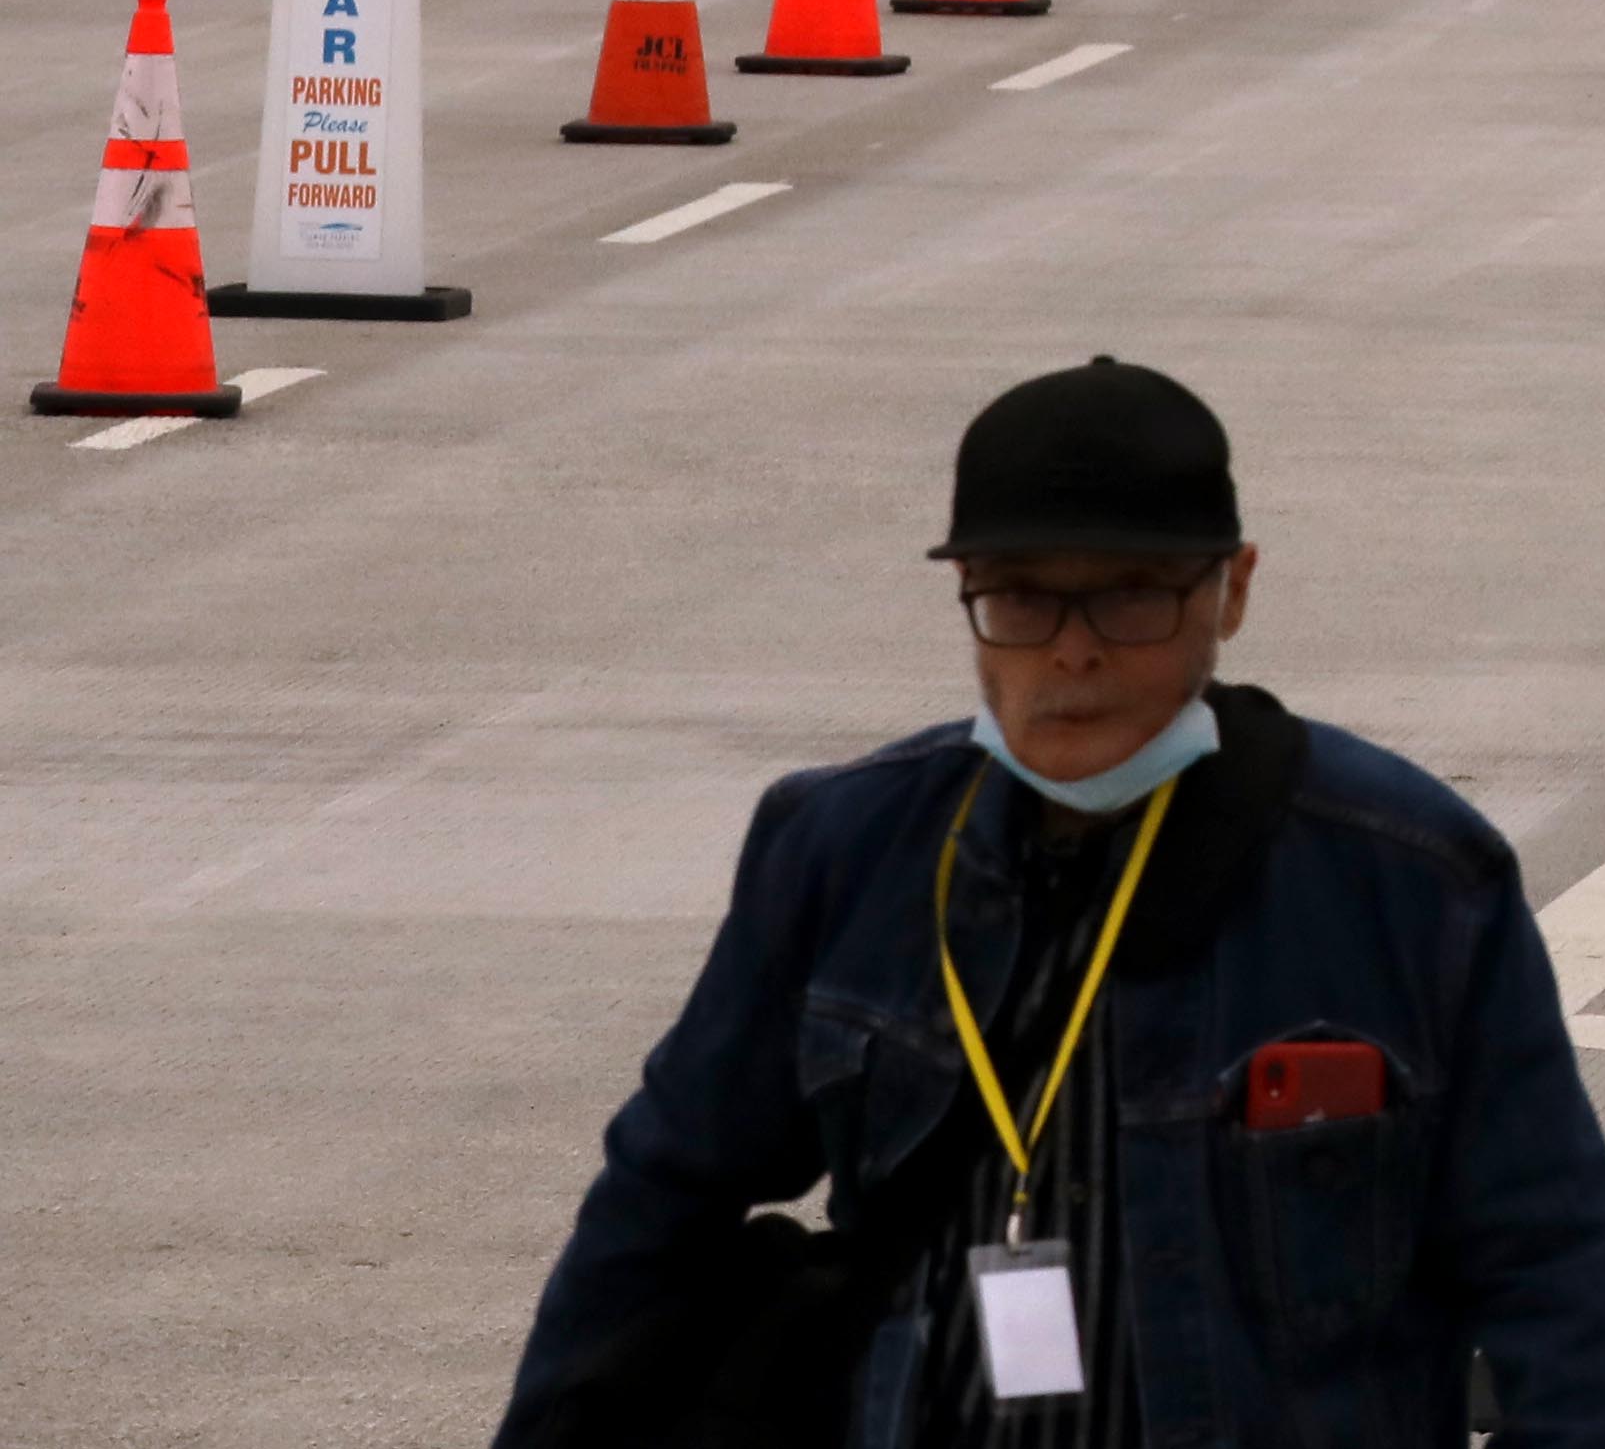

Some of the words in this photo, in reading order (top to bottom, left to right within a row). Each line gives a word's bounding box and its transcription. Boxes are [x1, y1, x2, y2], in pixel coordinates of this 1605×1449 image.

[635, 34, 688, 61] JCL
[292, 76, 382, 107] PARKING
[303, 110, 369, 134] Please
[290, 139, 376, 176] PULL
[288, 183, 377, 209] FORWARD
